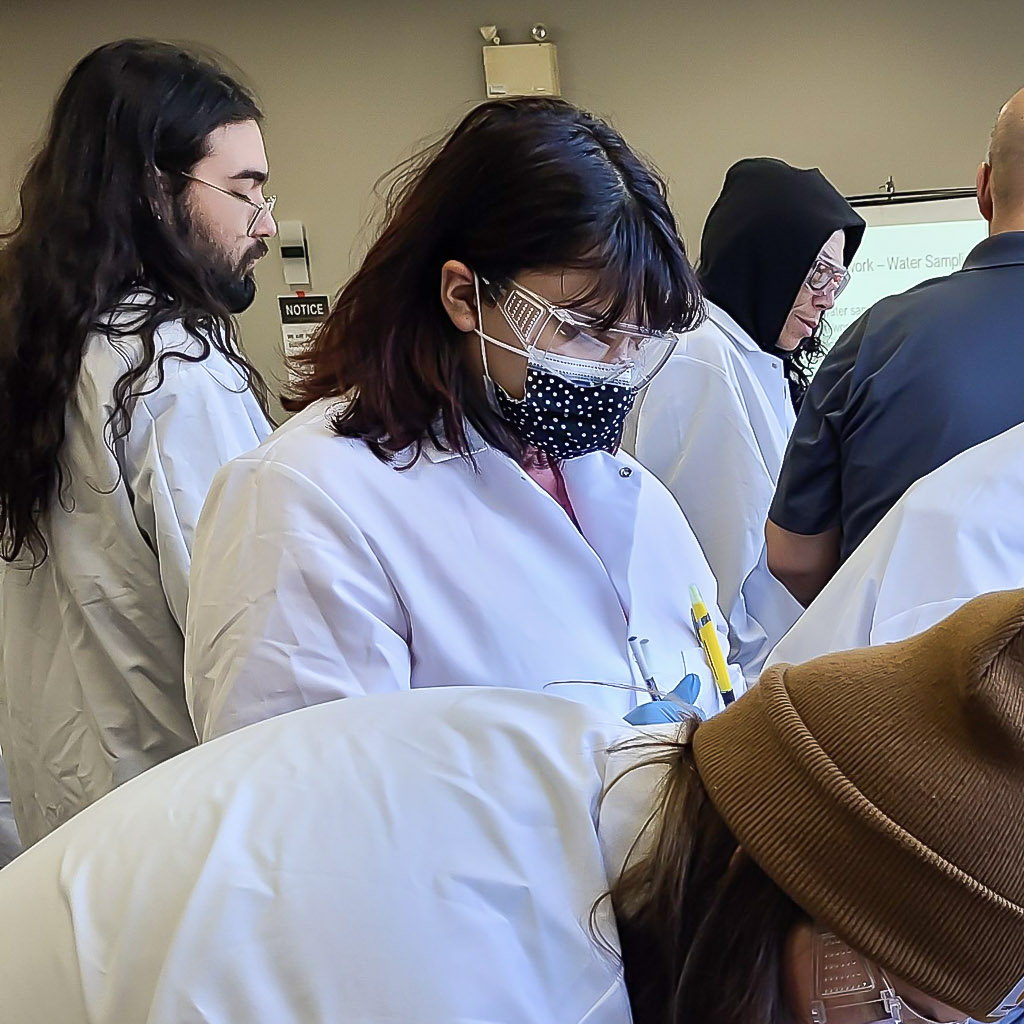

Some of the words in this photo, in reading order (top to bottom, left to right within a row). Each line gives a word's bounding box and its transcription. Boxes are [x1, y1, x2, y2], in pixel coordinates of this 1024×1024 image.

[851, 258, 874, 272] ork
[886, 257, 922, 270] Water
[286, 304, 324, 316] NOTICE
